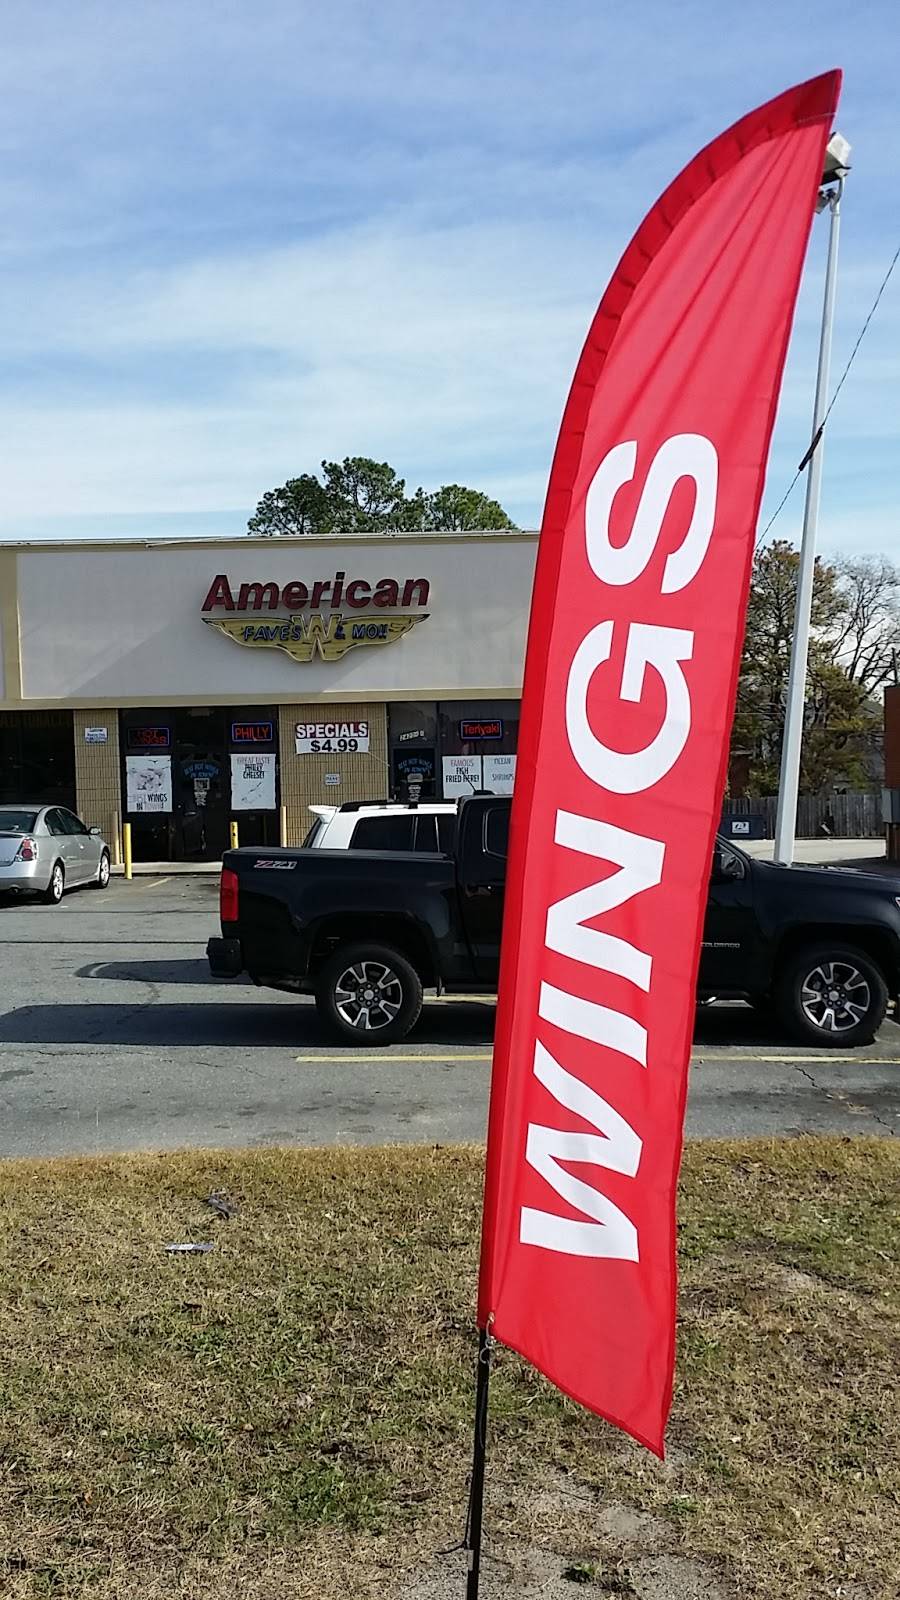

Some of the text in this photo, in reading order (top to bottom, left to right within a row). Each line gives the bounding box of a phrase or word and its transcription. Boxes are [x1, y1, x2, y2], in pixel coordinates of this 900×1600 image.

[201, 571, 430, 611] American
[243, 625, 302, 641] FAVES
[234, 726, 270, 740] PHILLY
[296, 722, 368, 739] SPECIALS
[463, 723, 499, 736] Teriyaki
[310, 738, 359, 752] $4.99
[450, 759, 474, 767] FAMOUS
[445, 774, 462, 783] FRIED
[147, 792, 168, 803] WINGS
[520, 433, 718, 1262] WINGS
